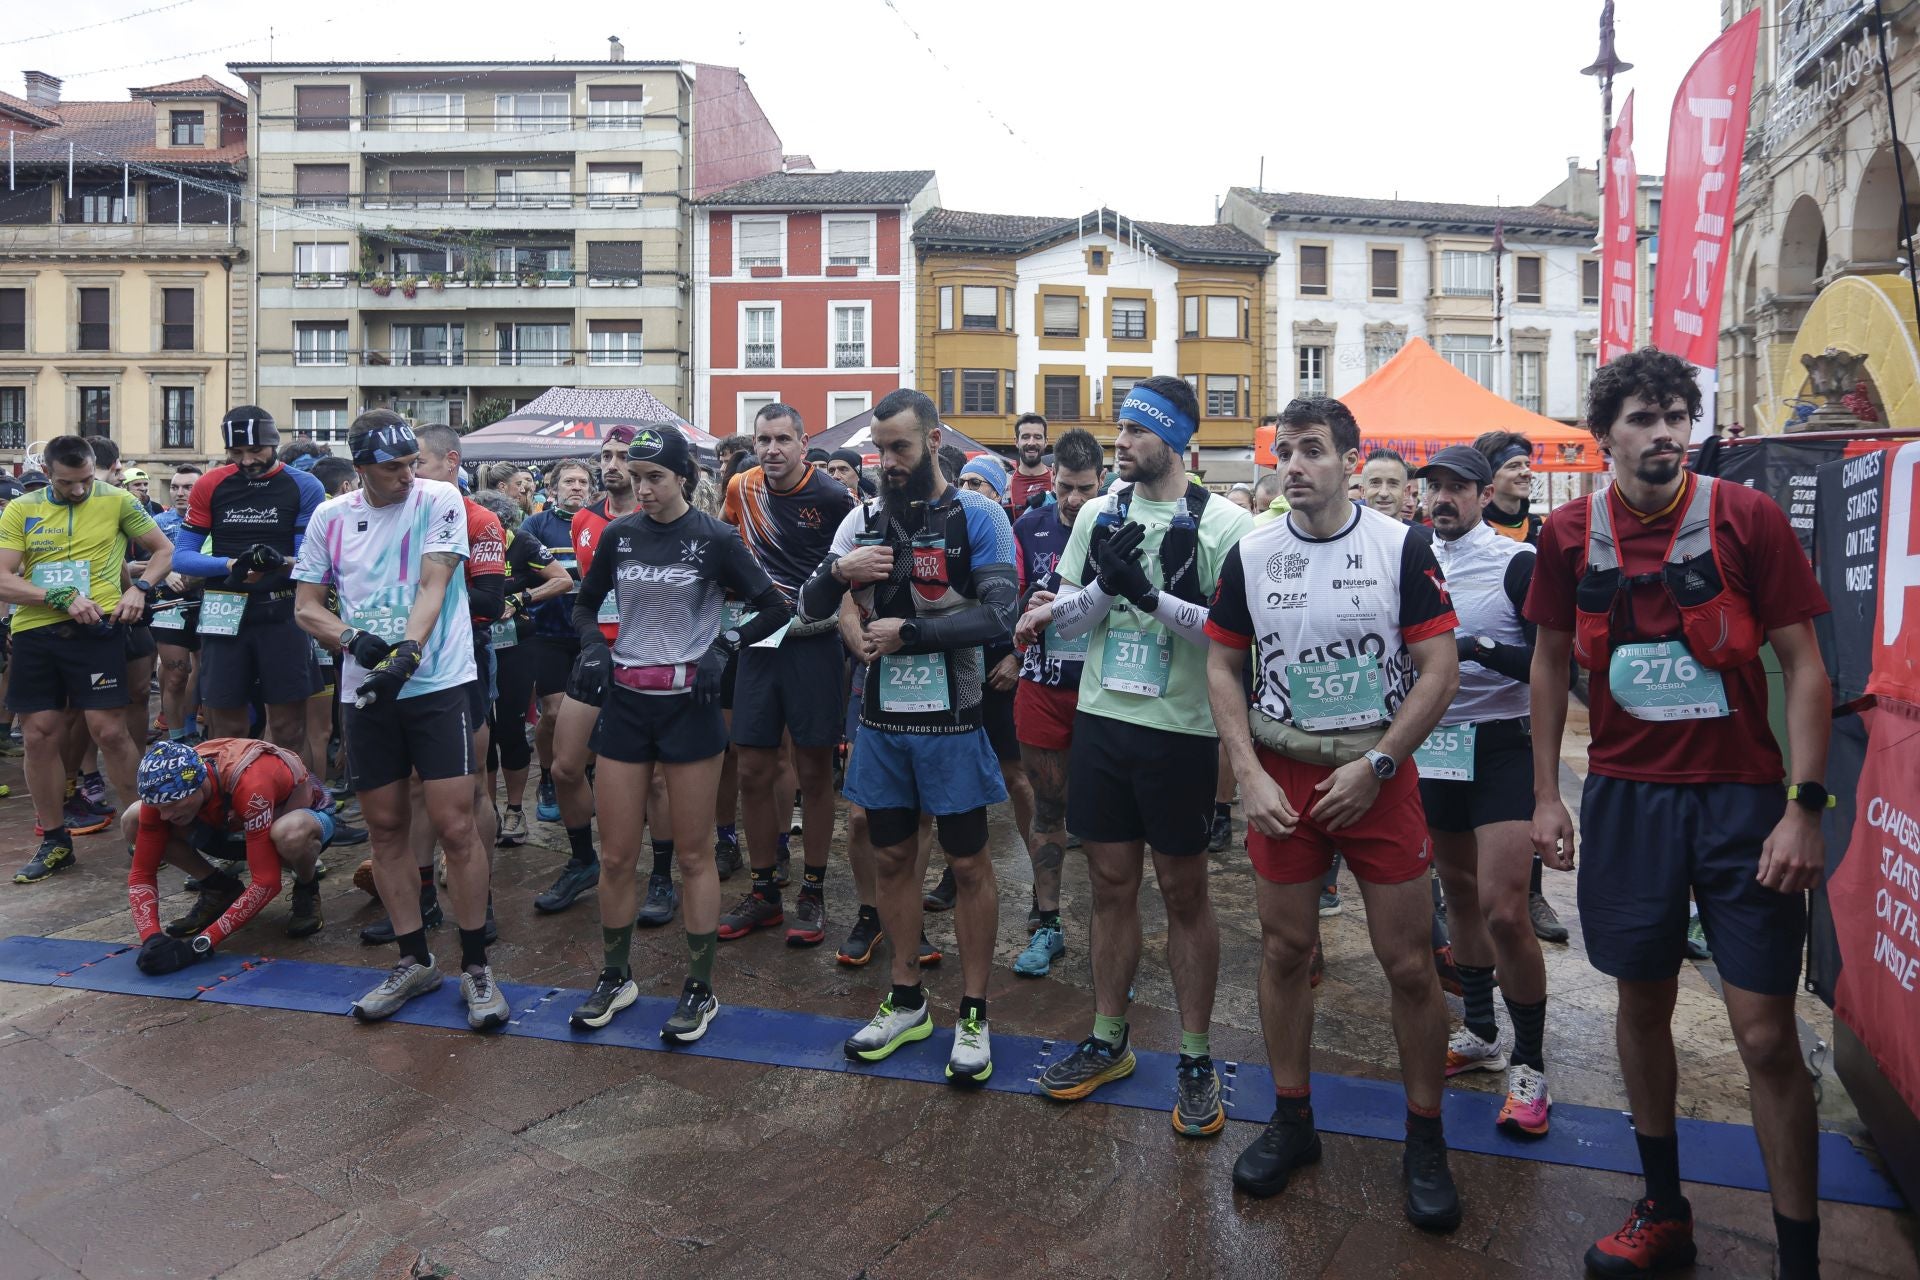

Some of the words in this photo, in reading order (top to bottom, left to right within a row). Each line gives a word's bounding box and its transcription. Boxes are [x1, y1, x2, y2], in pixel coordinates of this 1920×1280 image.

[1123, 398, 1175, 428] BROOKS
[1843, 450, 1883, 488] CHANGES
[1790, 504, 1803, 514] ON
[1847, 488, 1878, 521] STARTS
[472, 541, 503, 556] RECTA
[1846, 531, 1861, 557] ON
[1860, 526, 1876, 551] THE
[474, 552, 504, 563] FINAL
[1284, 552, 1301, 560] FISIO
[1284, 558, 1310, 567] CASTRO
[43, 569, 74, 583] 312
[616, 565, 704, 587] WOLVES
[917, 564, 939, 577] MAX
[1283, 565, 1305, 573] SPORT
[1283, 572, 1302, 580] TEAM
[1343, 578, 1378, 587] Nutergia
[1846, 564, 1874, 591] INSIDE
[203, 601, 231, 616] 380
[367, 617, 407, 637] 238
[1115, 641, 1149, 665] 311
[1116, 661, 1144, 670] ALBERTO
[1629, 655, 1697, 685] 276
[889, 666, 932, 685] 242
[1306, 671, 1360, 699] 367
[1646, 682, 1687, 691] JOSERRA
[1320, 695, 1354, 704] TXENTXO
[882, 723, 905, 732] TRAIL
[906, 725, 931, 733] PICOS
[944, 724, 974, 733] EUROPA
[243, 807, 272, 831] RECTA
[1874, 931, 1919, 991] INSDE
